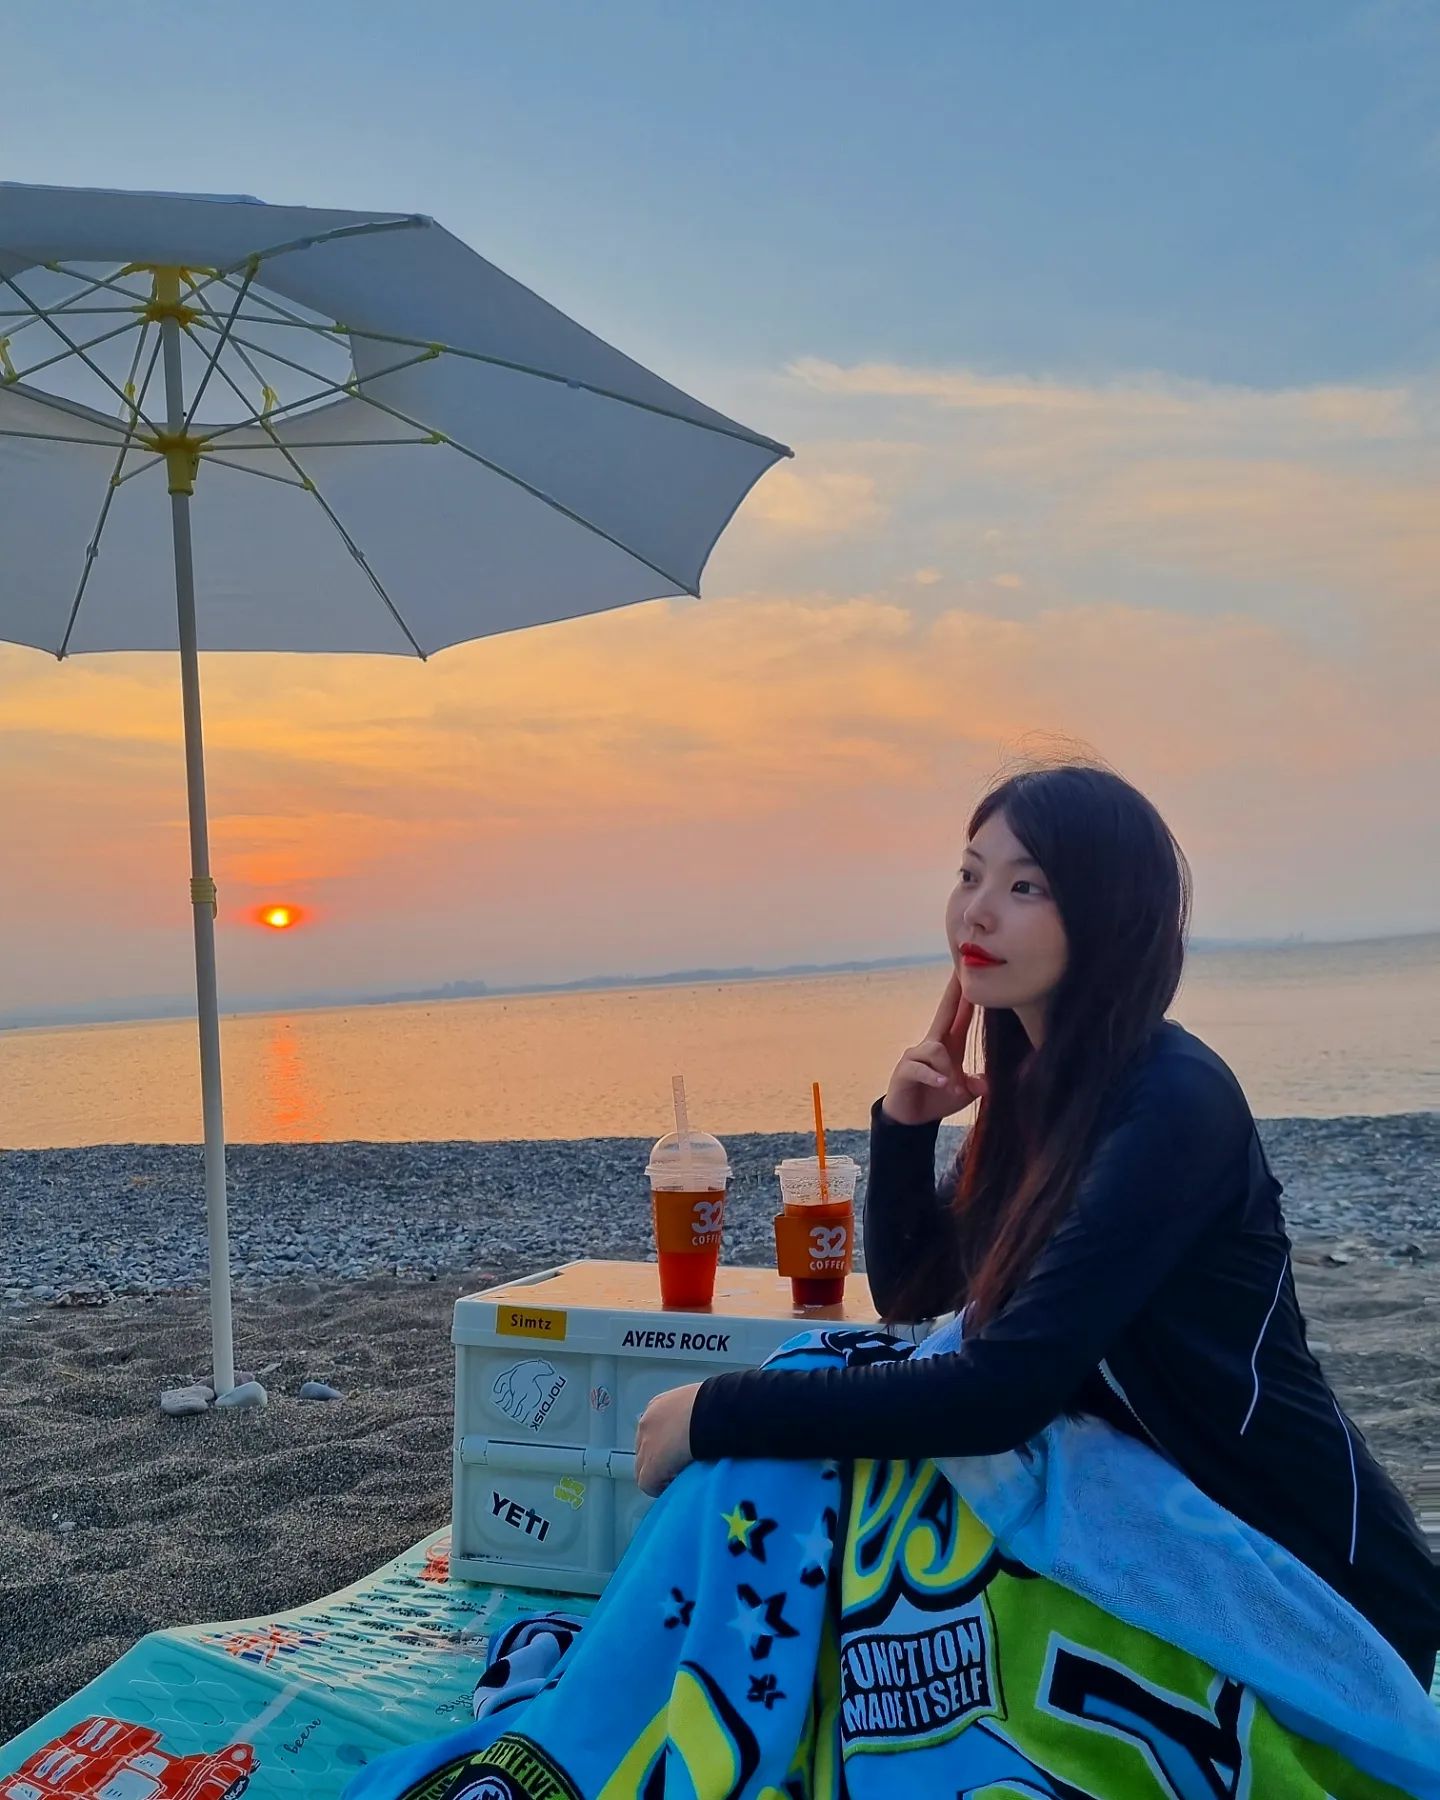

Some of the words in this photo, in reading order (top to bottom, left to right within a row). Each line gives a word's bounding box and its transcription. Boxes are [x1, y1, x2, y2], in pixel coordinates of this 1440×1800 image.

[691, 1200, 723, 1233] 32
[809, 1226, 847, 1258] 32
[510, 1313, 552, 1330] Simtz
[621, 1330, 677, 1349] AYERS
[679, 1332, 731, 1352] ROCK
[492, 1490, 550, 1542] YETI
[841, 1622, 981, 1699] FUNCTION
